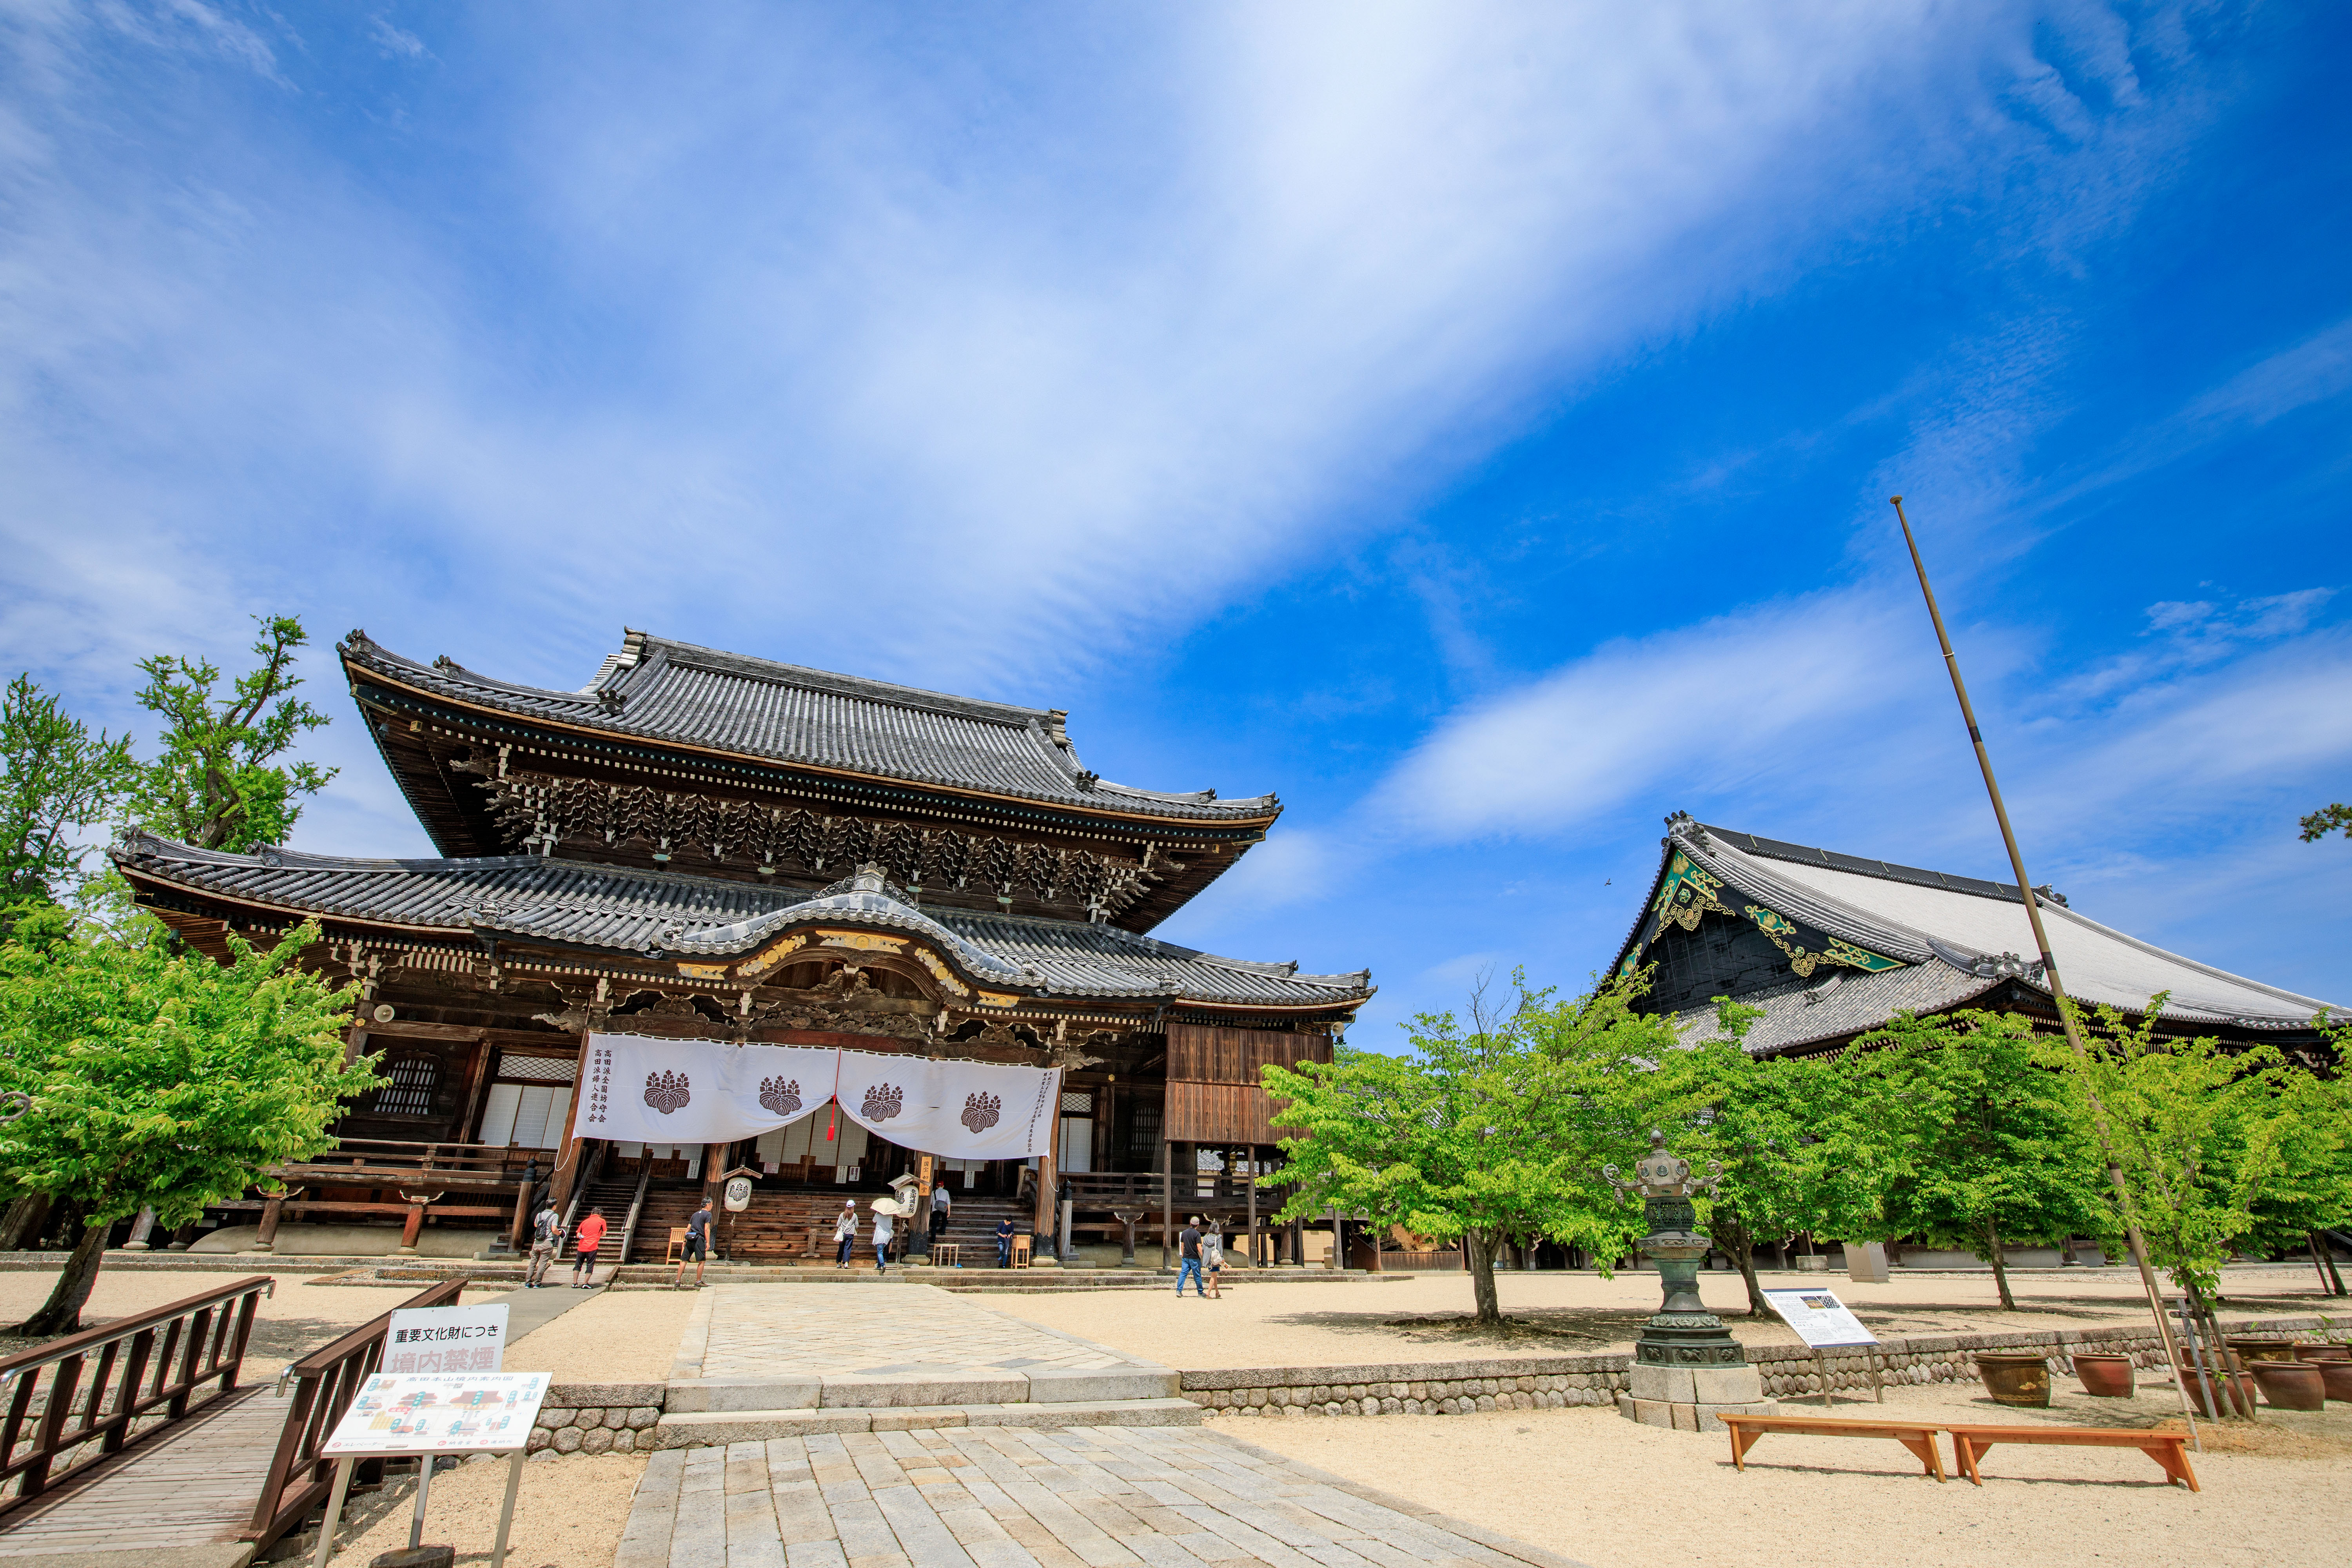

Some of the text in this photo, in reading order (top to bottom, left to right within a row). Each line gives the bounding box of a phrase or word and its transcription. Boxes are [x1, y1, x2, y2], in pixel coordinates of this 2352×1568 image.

[597, 1049, 612, 1123] 高田派全国坊守会
[395, 1325, 499, 1343] 重要文化財につき
[390, 1347, 495, 1374] 境内禁煙
